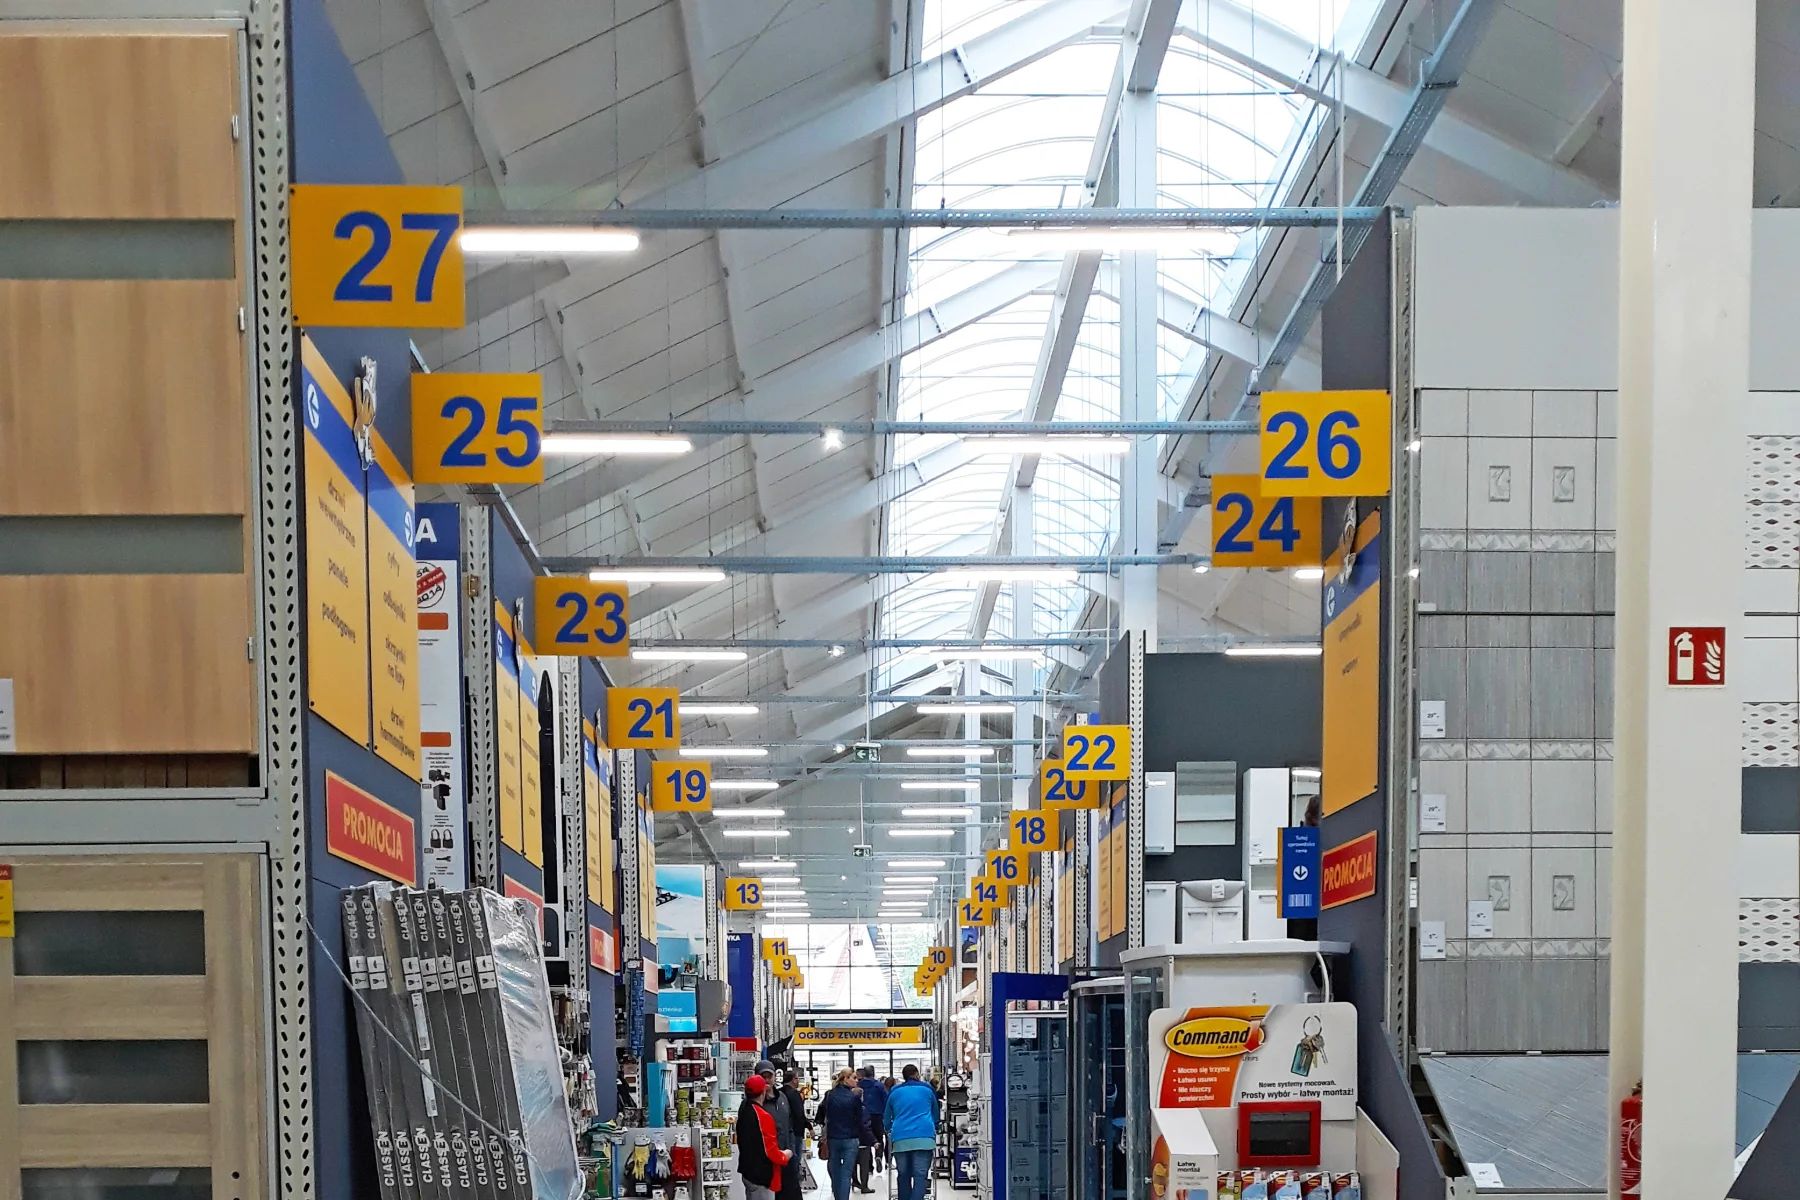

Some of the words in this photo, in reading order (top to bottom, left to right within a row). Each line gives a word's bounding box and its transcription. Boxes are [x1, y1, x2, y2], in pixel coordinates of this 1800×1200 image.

[333, 211, 460, 303] 27
[440, 396, 541, 467] 25
[1264, 411, 1361, 479] 26
[1215, 492, 1300, 553] 24
[555, 591, 628, 643] 23
[627, 698, 674, 738] 21
[1066, 735, 1116, 770] 22
[667, 769, 708, 802] 19
[1046, 769, 1086, 801] 20
[343, 803, 404, 863] PROMOCJA
[1015, 817, 1046, 844] 18
[991, 856, 1017, 879] 16
[1323, 851, 1373, 892] PROMOCJA
[737, 883, 760, 904] 13
[962, 907, 983, 921] 12
[975, 882, 998, 903] 14
[344, 895, 358, 939] CLASSEN
[361, 895, 376, 939] CLASSEN
[395, 896, 410, 940] CLASSEN
[414, 898, 429, 942] CLASSEN
[432, 895, 447, 939] CLASSEN
[450, 900, 465, 944] CLASSEN
[468, 894, 484, 939] CLASSEN
[772, 941, 786, 956] 11
[782, 958, 792, 971] 9
[930, 950, 946, 964] 10
[799, 1030, 835, 1040] OGRÓD
[838, 1031, 903, 1041] ZEWNĘTRZNY
[1174, 1026, 1250, 1046] Command
[1241, 1091, 1266, 1099] Prosty
[1267, 1090, 1291, 1099] wybór
[1300, 1089, 1321, 1098] łatwy
[1322, 1088, 1354, 1096] montaż!
[377, 1131, 395, 1186] CLASSEN
[396, 1131, 413, 1187] CLASSEN
[415, 1127, 433, 1183] CLASSEN
[434, 1131, 452, 1187] CLASSEN
[451, 1132, 470, 1188] CLASSEN
[470, 1130, 488, 1185] CLASSEN
[489, 1135, 507, 1190] CLASSEN
